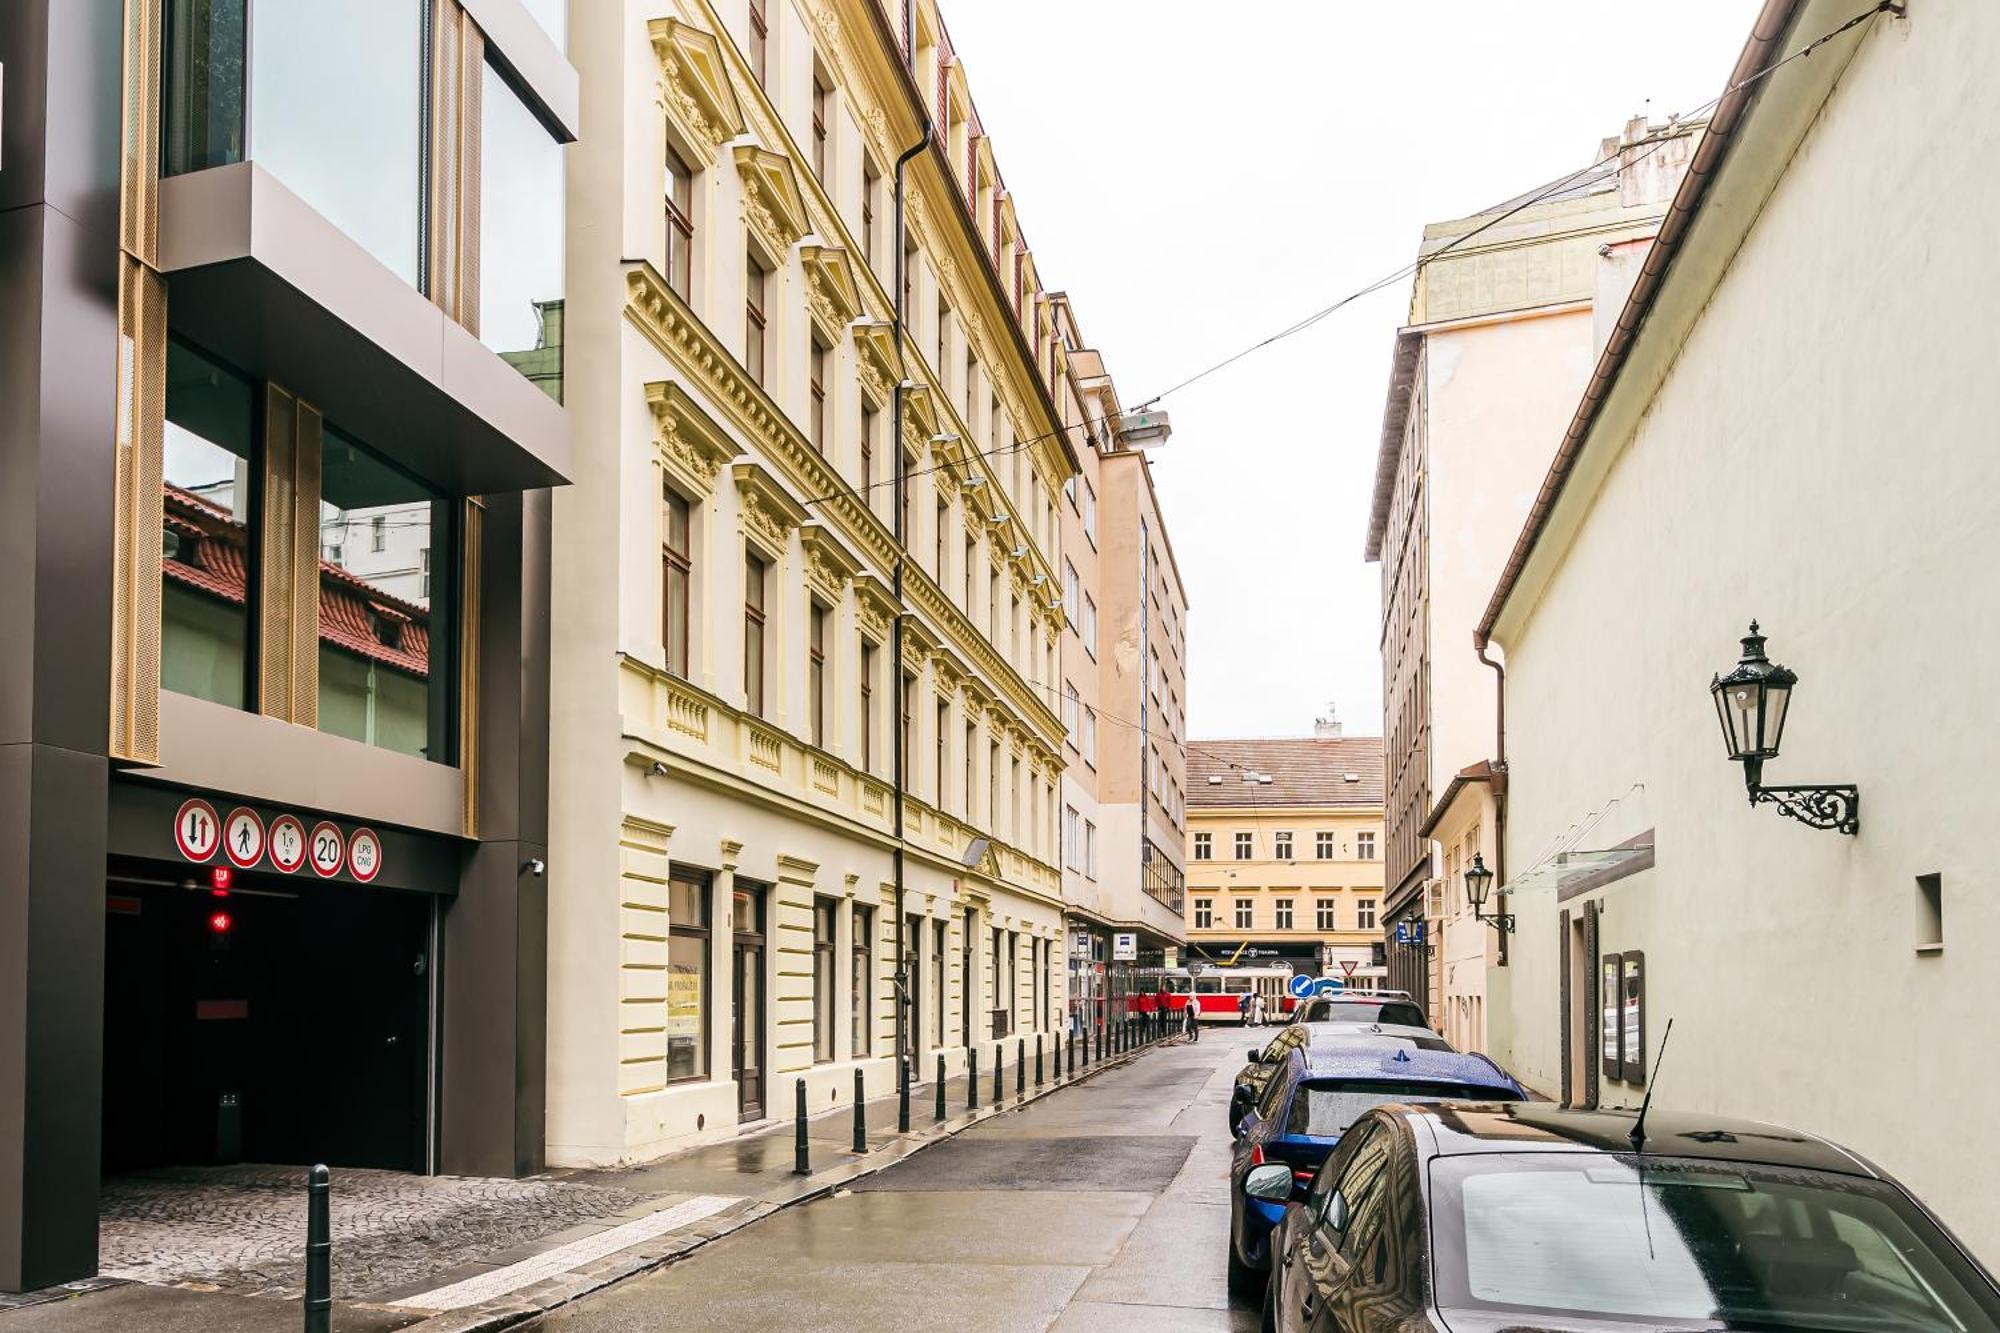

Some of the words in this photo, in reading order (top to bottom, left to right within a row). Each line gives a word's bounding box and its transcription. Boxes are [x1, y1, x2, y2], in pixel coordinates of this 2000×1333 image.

[317, 837, 338, 863] 20
[358, 844, 372, 855] LPG
[357, 856, 372, 867] CNG
